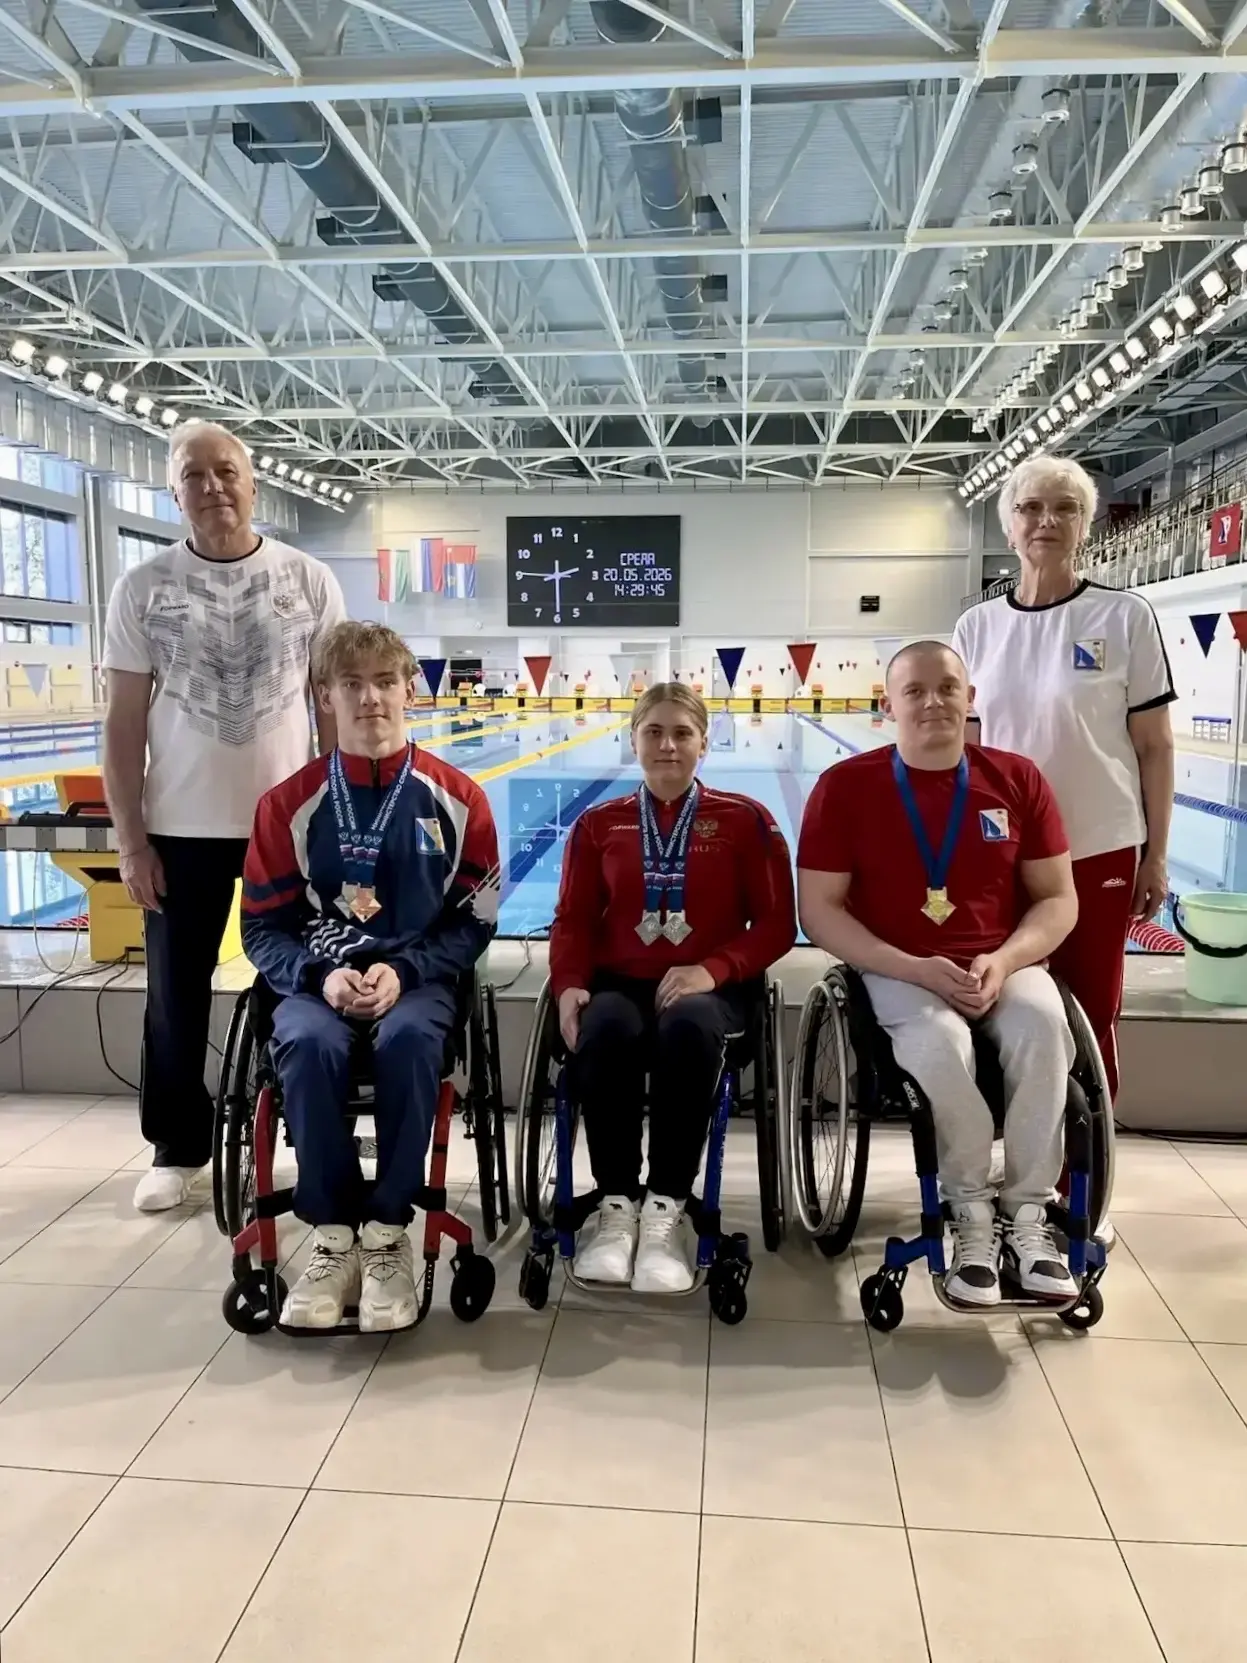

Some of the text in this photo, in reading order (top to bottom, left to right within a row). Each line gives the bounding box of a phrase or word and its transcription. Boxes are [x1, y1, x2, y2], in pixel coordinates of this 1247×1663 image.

[551, 527, 563, 537] 12
[533, 533, 543, 543] 11
[573, 533, 579, 543] 1
[517, 549, 531, 559] 10
[586, 549, 594, 559] 2
[515, 570, 524, 580] 9
[591, 570, 599, 580] 3
[603, 568, 672, 581] 20.05.2026
[614, 584, 665, 596] 14:29:45
[520, 592, 528, 602] 8
[586, 592, 594, 602] 4
[534, 608, 542, 618] 7
[572, 608, 580, 618] 5
[553, 614, 561, 624] 6
